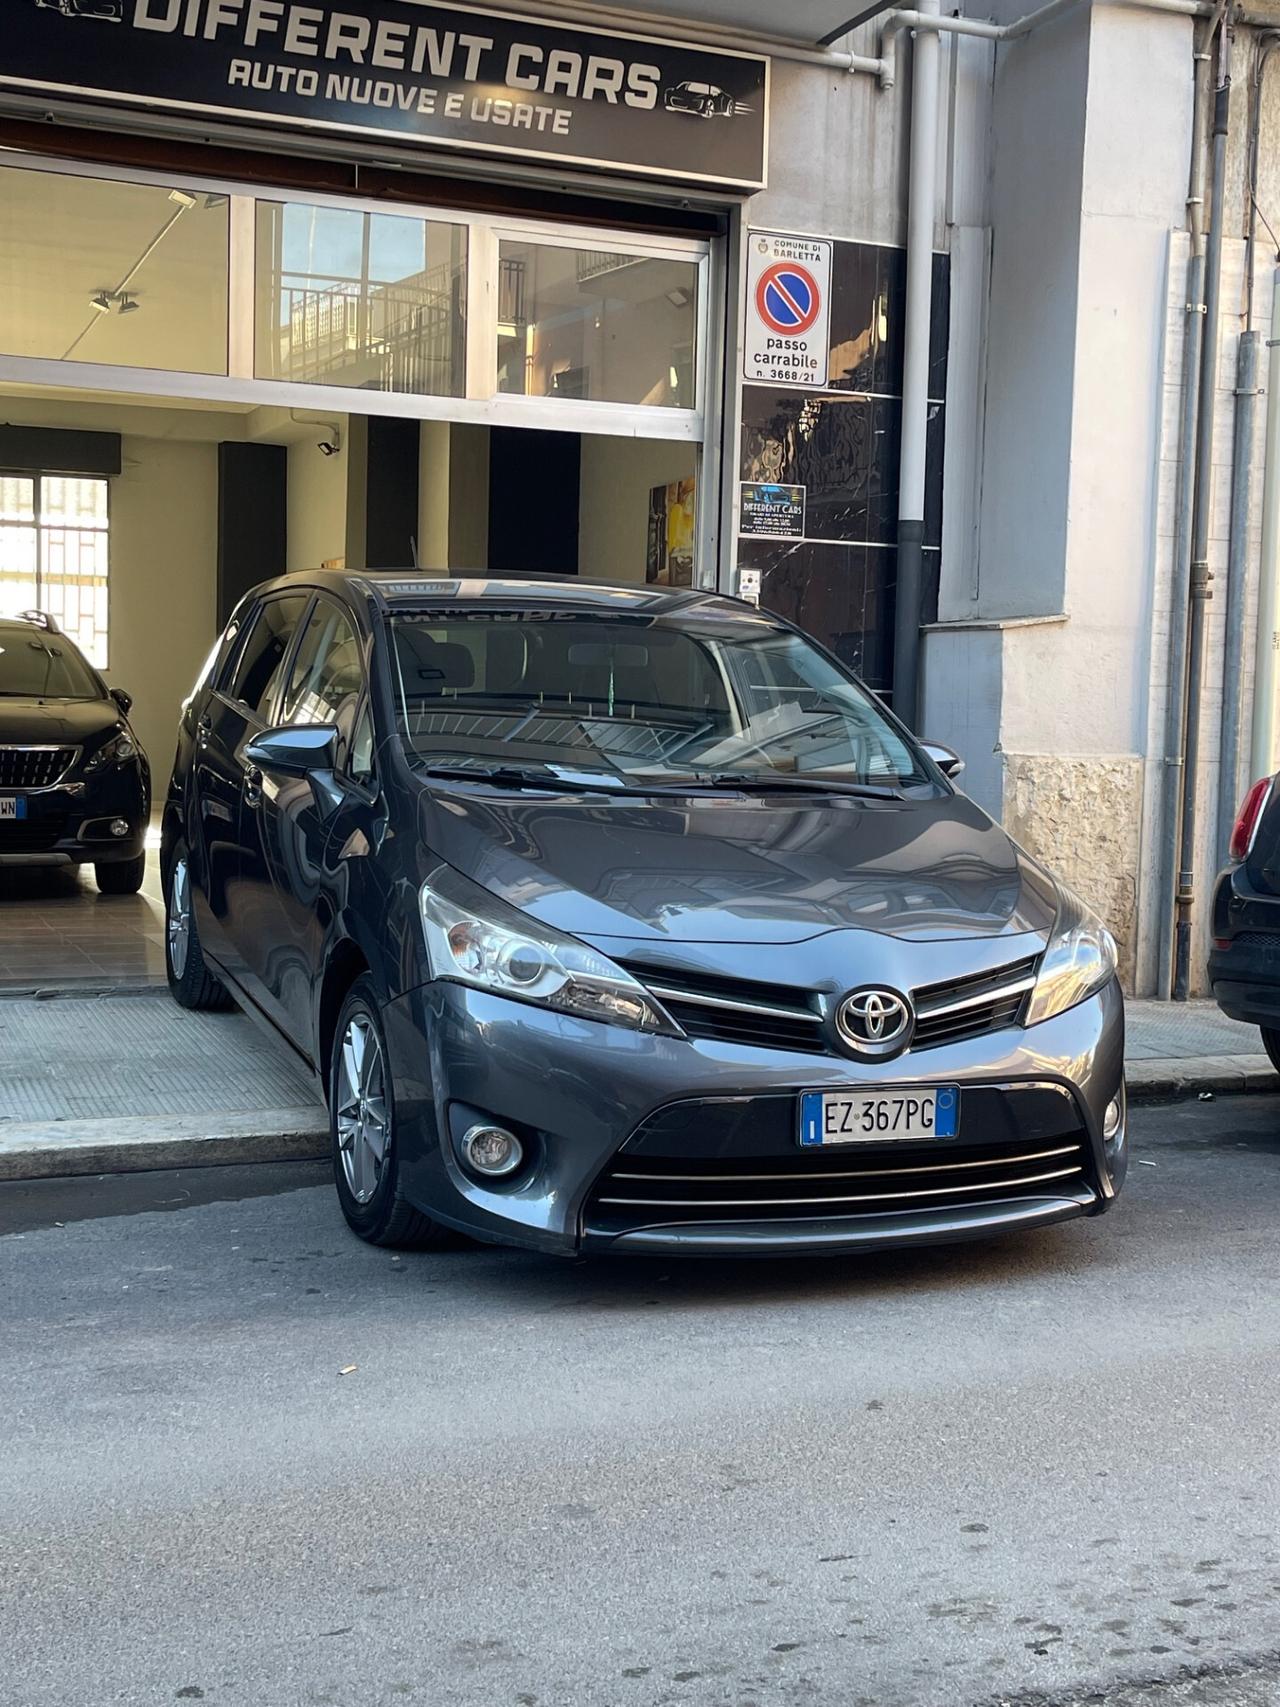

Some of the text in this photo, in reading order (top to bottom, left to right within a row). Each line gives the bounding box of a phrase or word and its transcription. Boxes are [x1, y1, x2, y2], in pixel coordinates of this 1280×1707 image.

[133, 0, 661, 110] DIFFERENT CARS
[228, 59, 573, 135] AUTO NUOVE E USATE
[774, 239, 821, 252] COMUNE DI
[774, 248, 821, 262] BARLETTA
[766, 337, 808, 351] passo
[754, 352, 818, 369] carrabile
[756, 369, 815, 382] n. 3668/21
[743, 503, 780, 513] DIFFERENT
